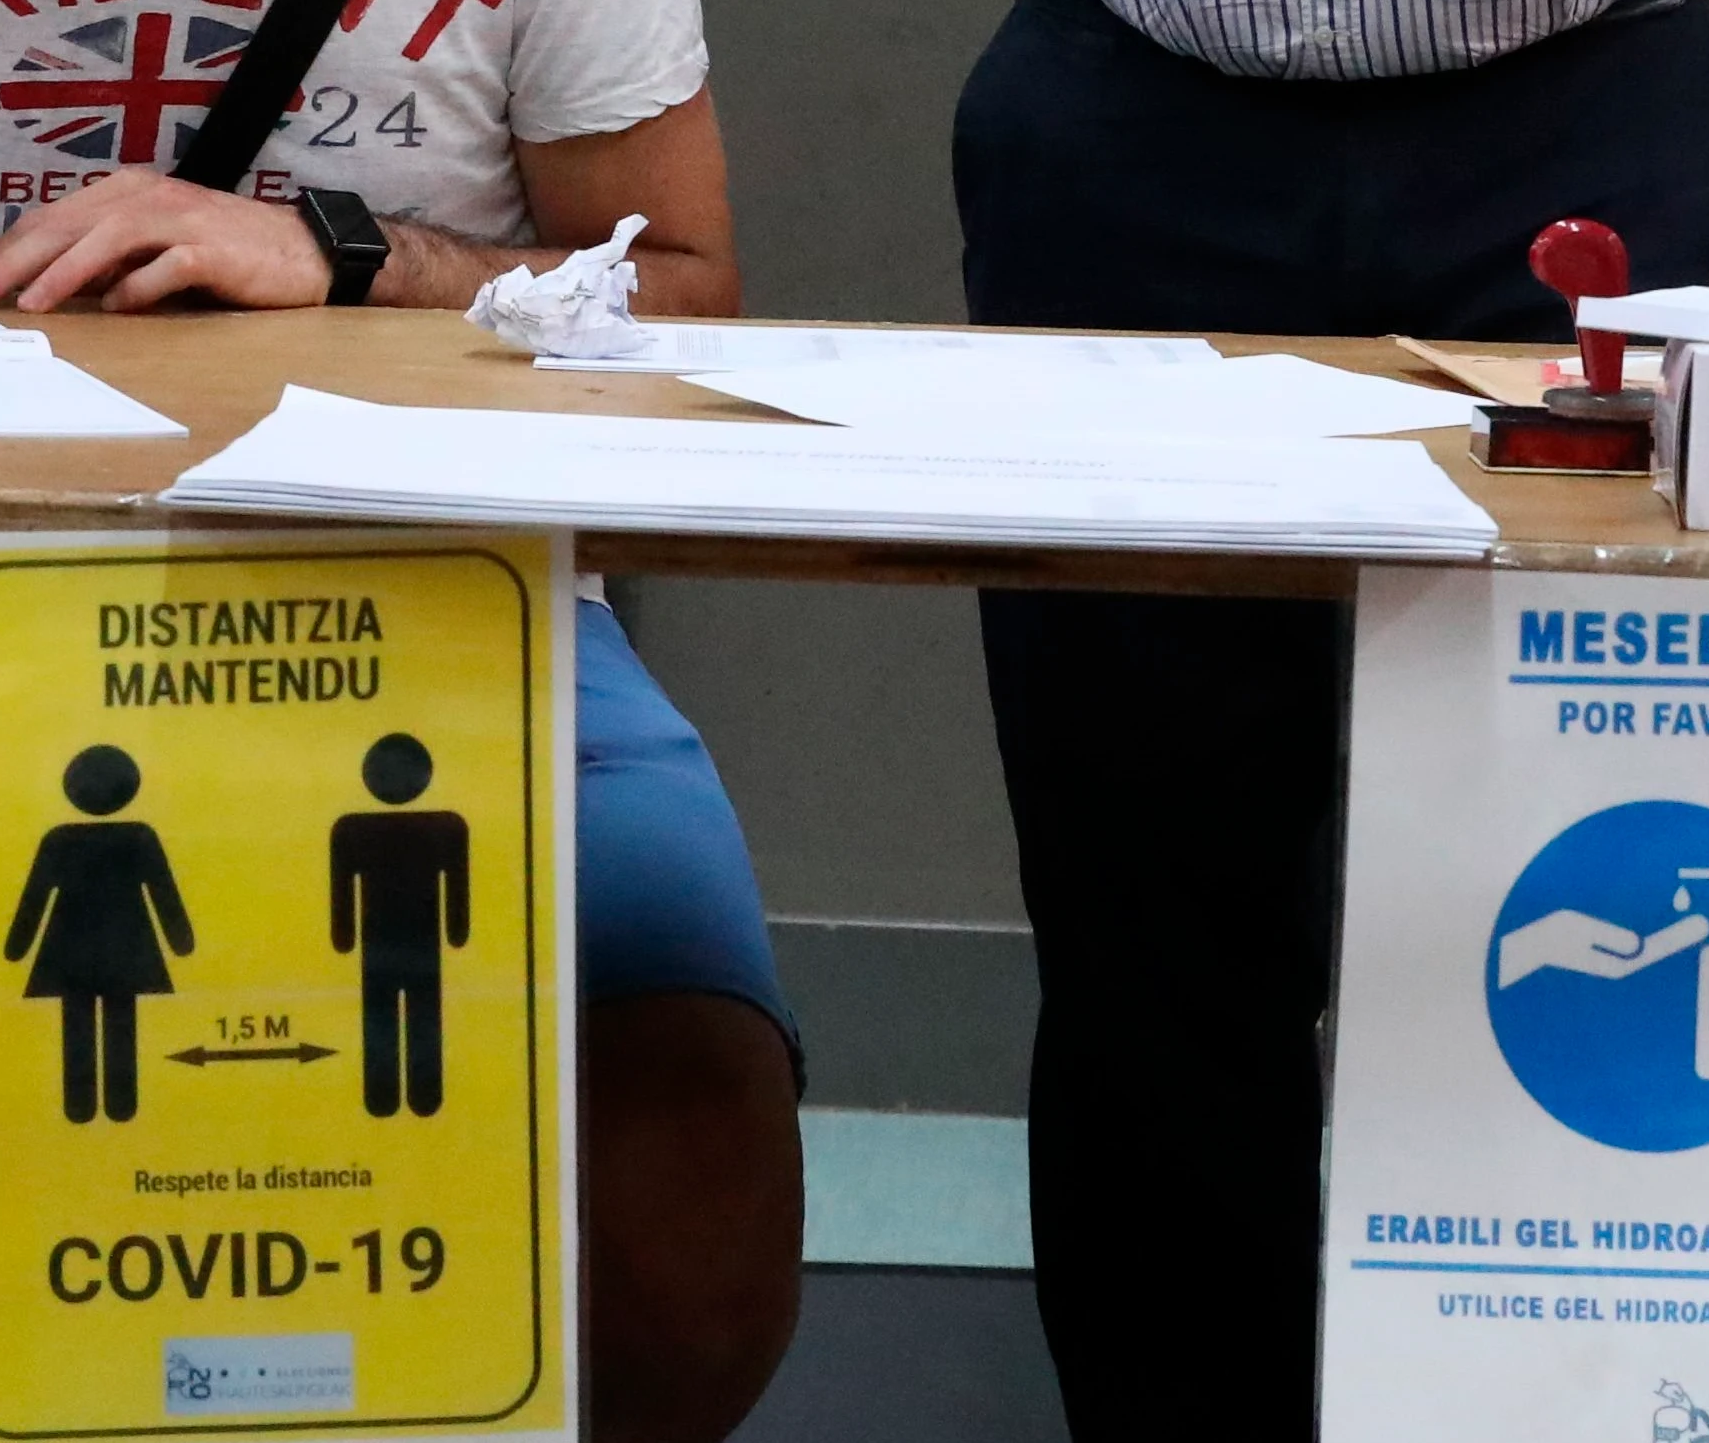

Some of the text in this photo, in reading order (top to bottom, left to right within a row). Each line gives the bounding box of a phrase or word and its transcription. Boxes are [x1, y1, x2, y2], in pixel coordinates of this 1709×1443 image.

[307, 85, 428, 148] 24
[100, 597, 382, 648] DISTANTZIA
[106, 656, 379, 706] MANTENDU
[1559, 701, 1635, 734] POR
[216, 1015, 289, 1043] 1,5 M
[135, 1166, 372, 1198] Respete la distancia
[1367, 1214, 1500, 1245] ERABILI
[1516, 1219, 1578, 1248] GEL
[49, 1227, 444, 1303] COVID-19
[1439, 1294, 1543, 1319] UTILICE
[1555, 1297, 1604, 1320] GEL
